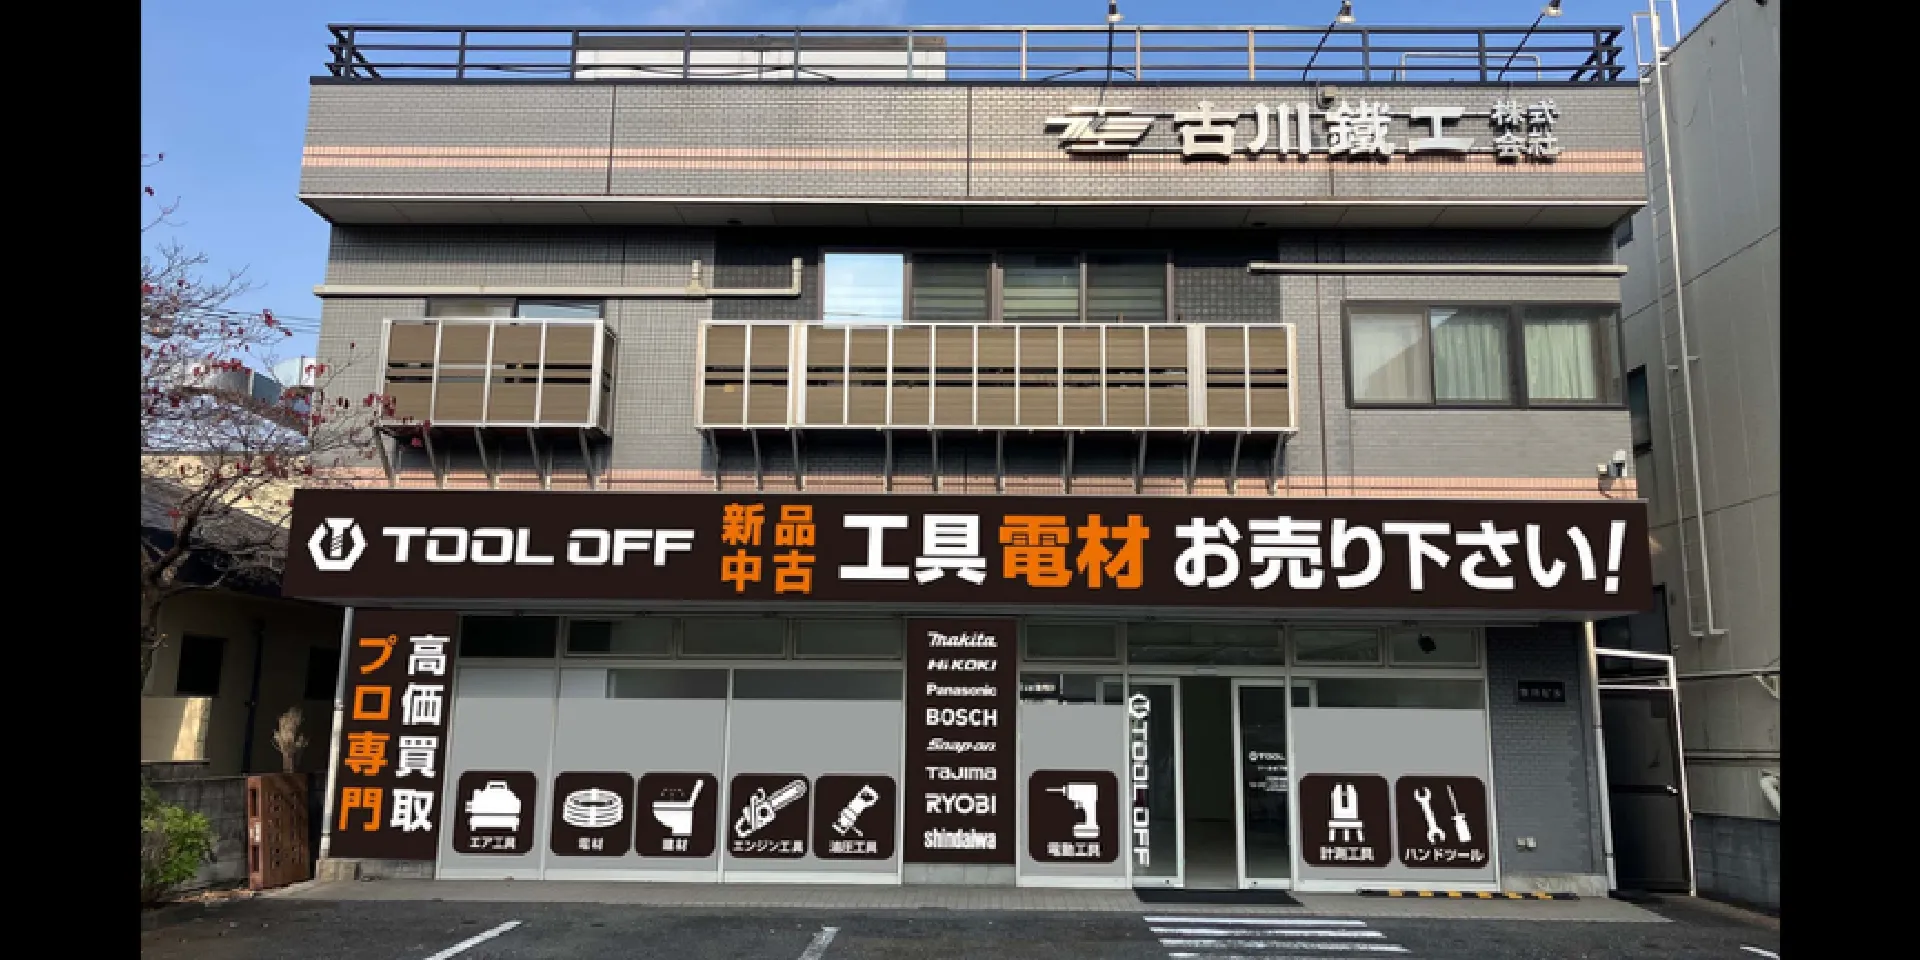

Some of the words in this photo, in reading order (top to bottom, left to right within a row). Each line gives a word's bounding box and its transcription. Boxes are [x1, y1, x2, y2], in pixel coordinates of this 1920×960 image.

[1173, 100, 1475, 157] 古川鐵工
[721, 502, 816, 547] 新品
[382, 526, 554, 566] TOOL
[566, 528, 695, 566] OFF
[839, 513, 988, 586] 工具
[999, 513, 1151, 590] 電材
[1174, 515, 1626, 594] お売り下さい!
[721, 549, 816, 594] 中古
[926, 681, 997, 697] Panasonic
[338, 633, 398, 832] プロ専門
[389, 633, 451, 832] 高価買取
[926, 708, 998, 727] BOSCH
[1131, 720, 1149, 804] TOOL
[925, 792, 997, 815] RYOBI
[469, 836, 516, 850] エア工具
[733, 840, 806, 854] エンジン工具
[924, 827, 997, 850] shindaiwa
[1132, 806, 1150, 868] OFF
[1404, 848, 1485, 861] ハンドツール
